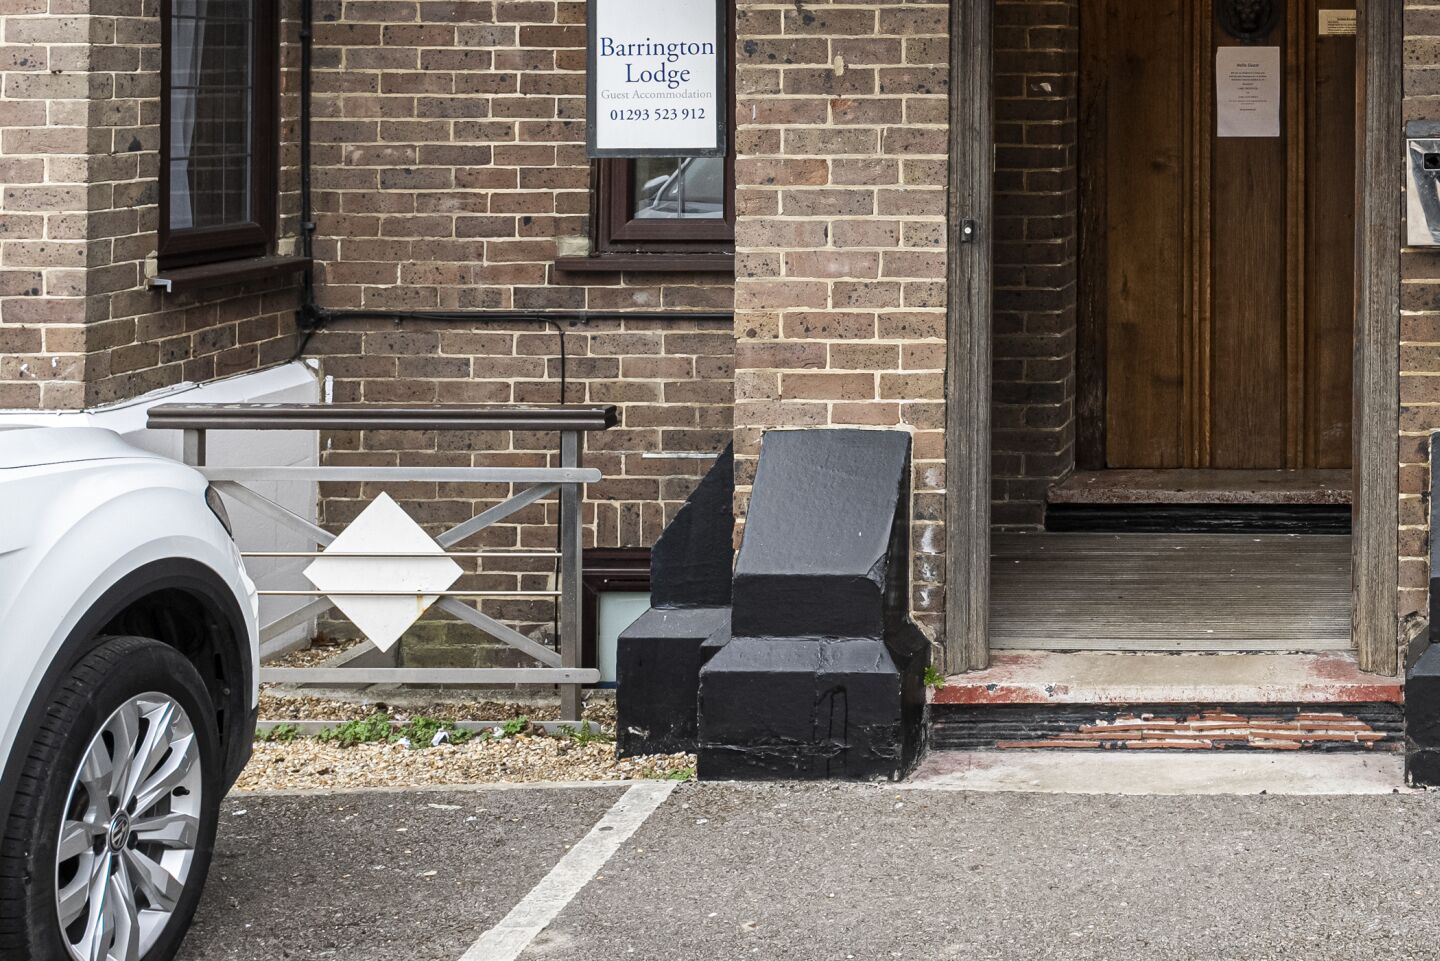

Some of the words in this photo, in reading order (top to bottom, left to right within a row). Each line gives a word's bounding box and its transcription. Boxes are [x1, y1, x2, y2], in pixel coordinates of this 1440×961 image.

[600, 37, 715, 63] Barrington
[625, 62, 691, 89] Lodge
[601, 89, 629, 100] Guest
[632, 89, 712, 99] Accommodation
[610, 109, 650, 121] 01293
[654, 108, 678, 121] 523
[681, 108, 706, 121] 912
